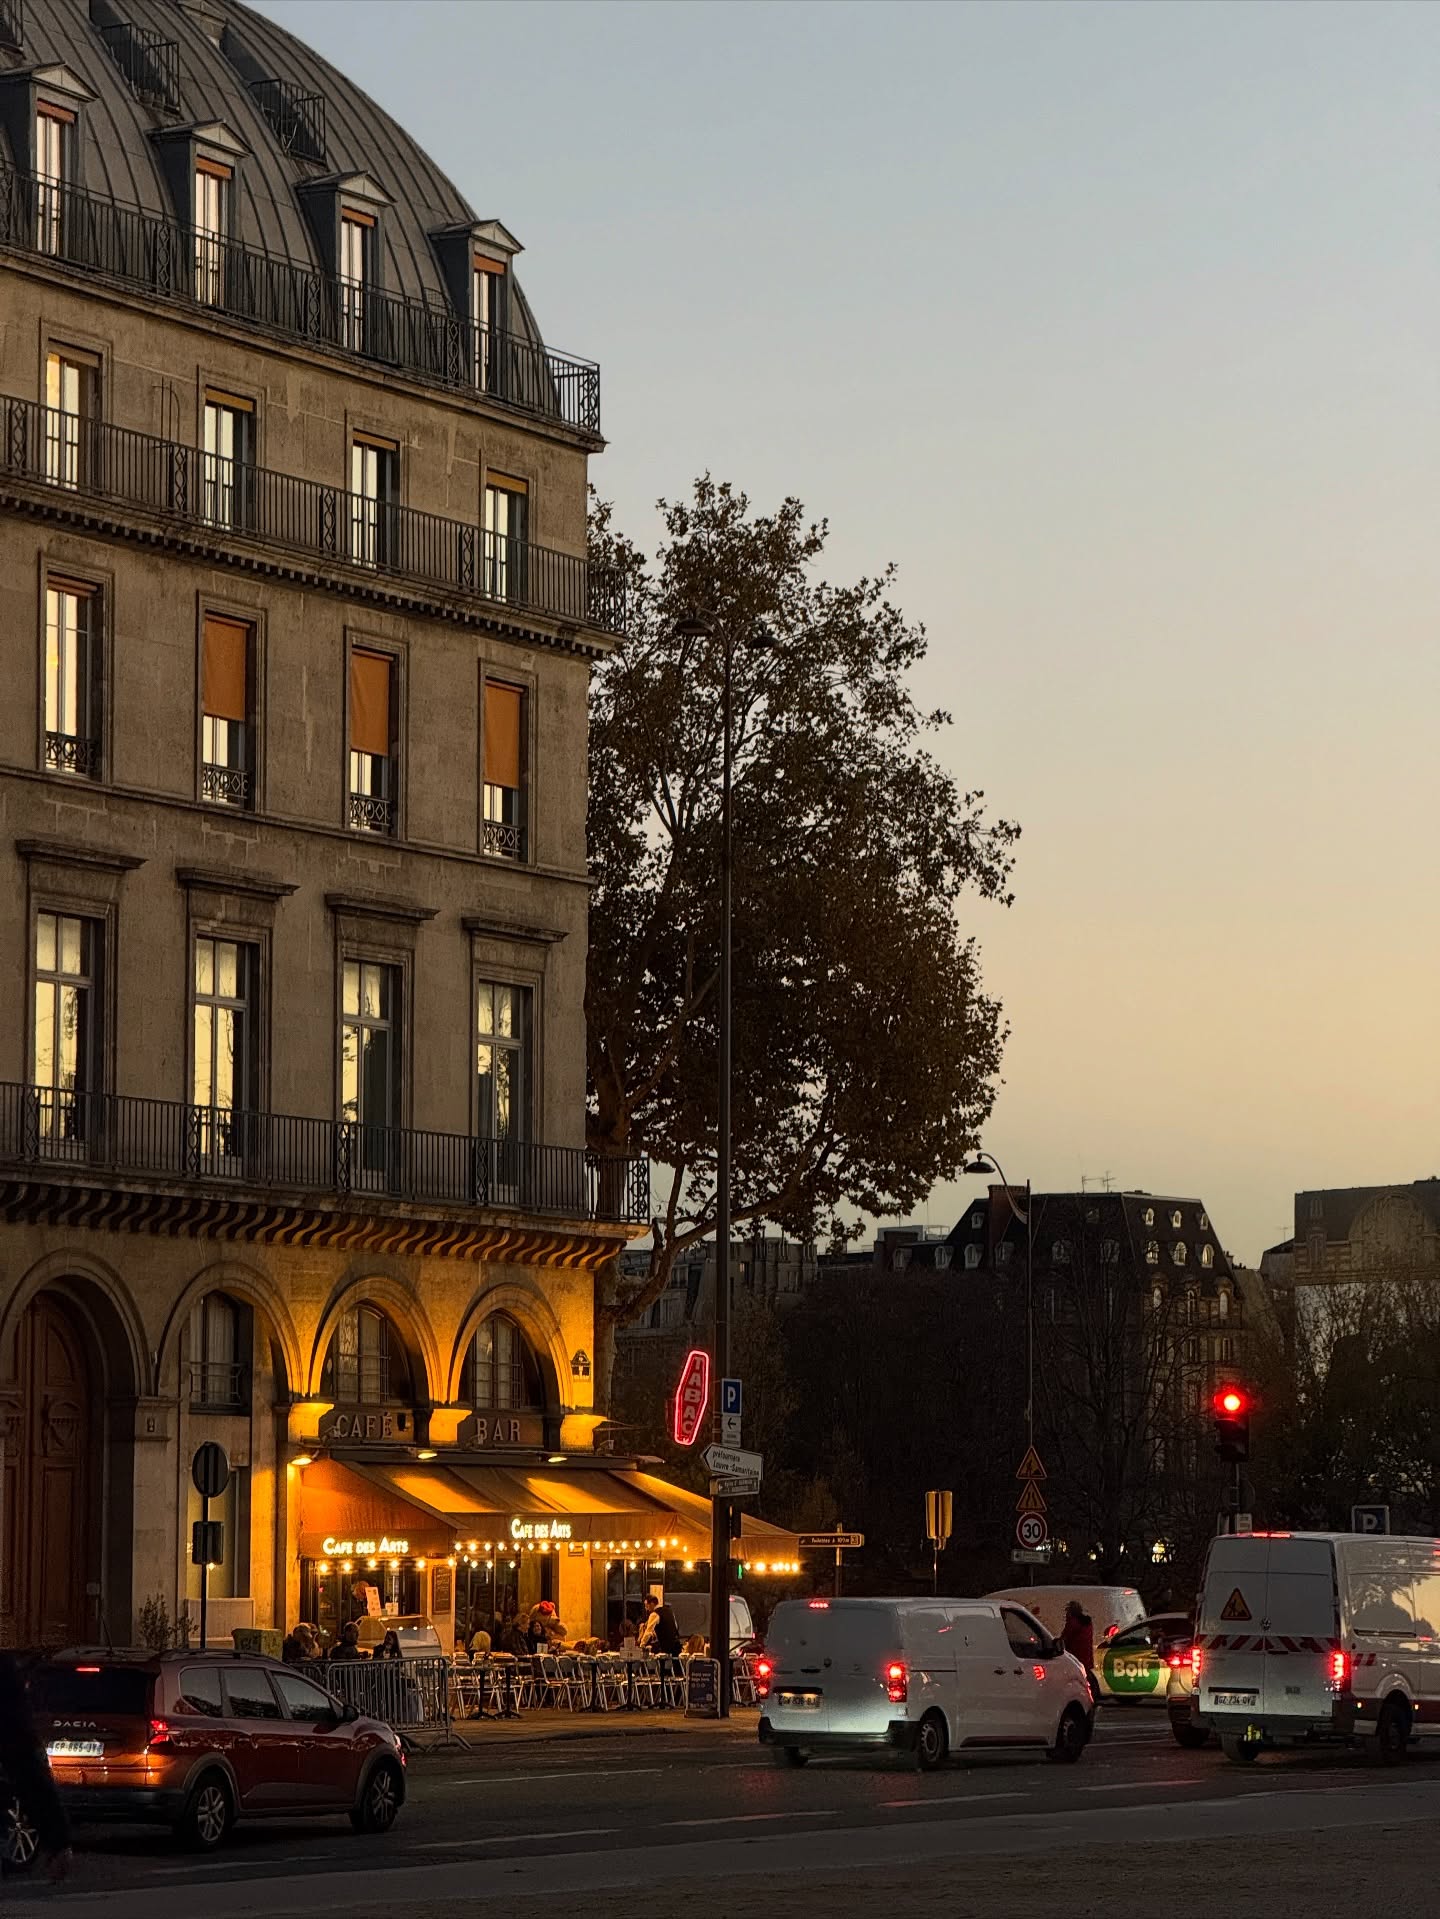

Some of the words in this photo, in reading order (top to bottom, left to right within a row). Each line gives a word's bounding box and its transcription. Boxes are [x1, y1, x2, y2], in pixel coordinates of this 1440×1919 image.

[683, 1356, 704, 1434] TABAC
[727, 1386, 736, 1409] P
[335, 1411, 393, 1438] CAFÉ
[477, 1418, 521, 1442] BAR
[1024, 1522, 1041, 1539] 30
[1362, 1513, 1377, 1530] P
[1113, 1658, 1150, 1678] Bolt
[53, 1720, 97, 1728] DACIA
